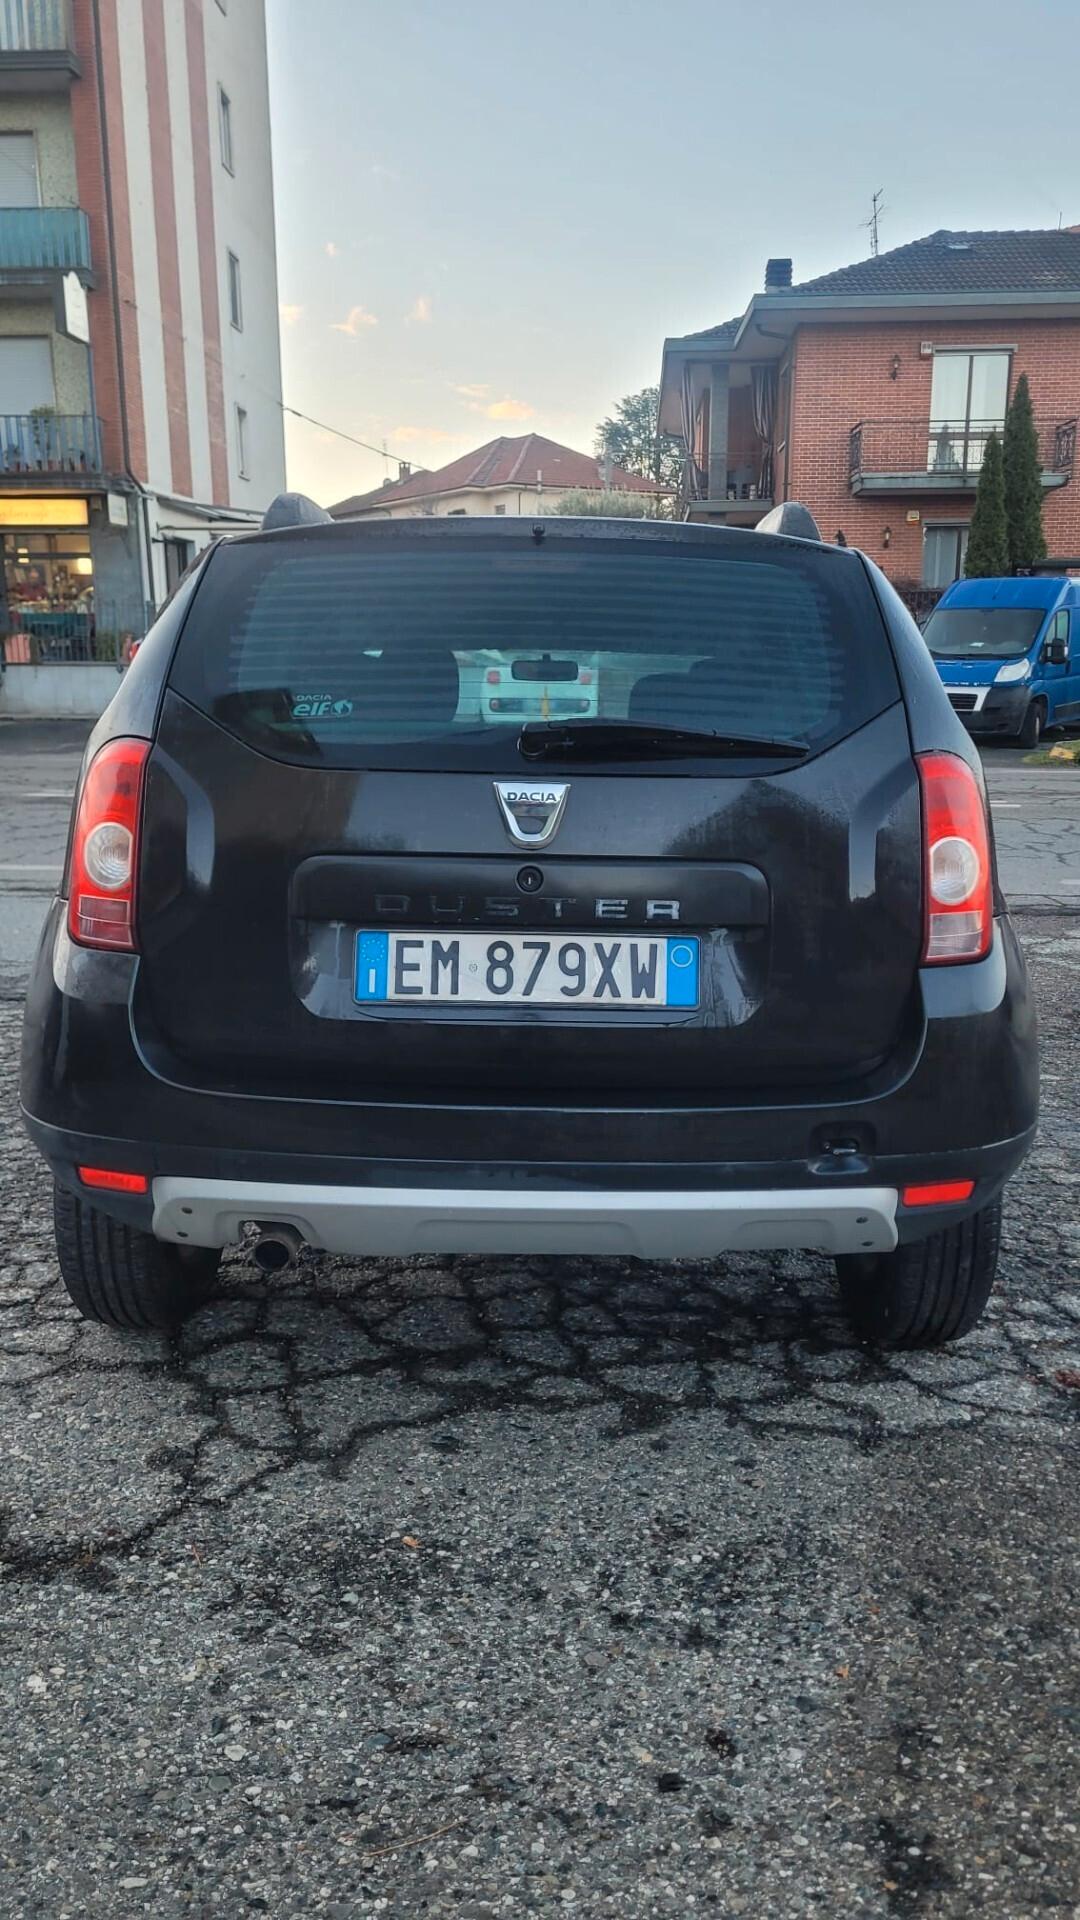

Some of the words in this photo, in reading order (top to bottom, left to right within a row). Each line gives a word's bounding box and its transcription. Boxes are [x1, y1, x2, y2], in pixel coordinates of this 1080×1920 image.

[507, 792, 557, 802] DACIA
[374, 894, 680, 920] DUSTER
[394, 940, 460, 995] EM
[485, 940, 658, 998] 879XW
